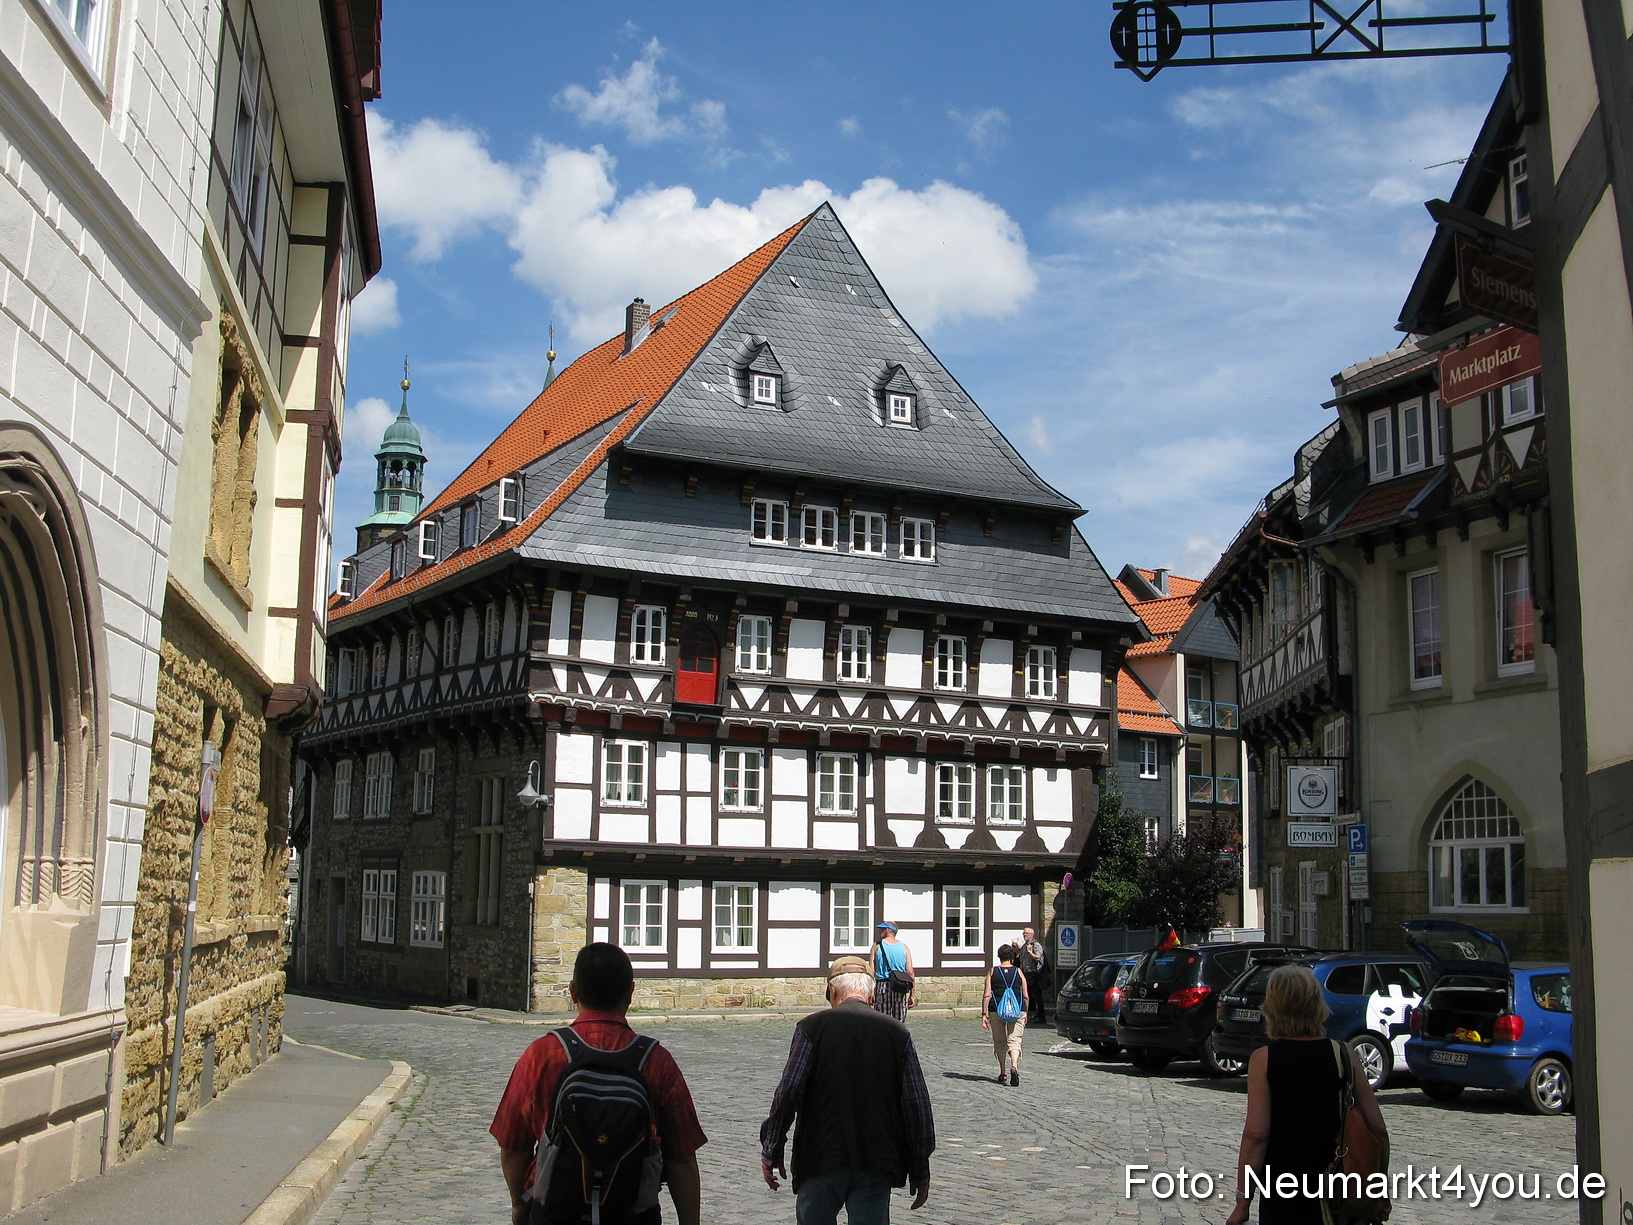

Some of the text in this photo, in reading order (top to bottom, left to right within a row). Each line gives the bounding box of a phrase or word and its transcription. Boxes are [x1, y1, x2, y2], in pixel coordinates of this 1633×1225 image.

[1471, 267, 1538, 309] Siemens
[1449, 344, 1521, 385] Marktplatz
[1293, 831, 1334, 841] BOMBAY
[1350, 828, 1361, 850] P
[1454, 1054, 1467, 1064] 233
